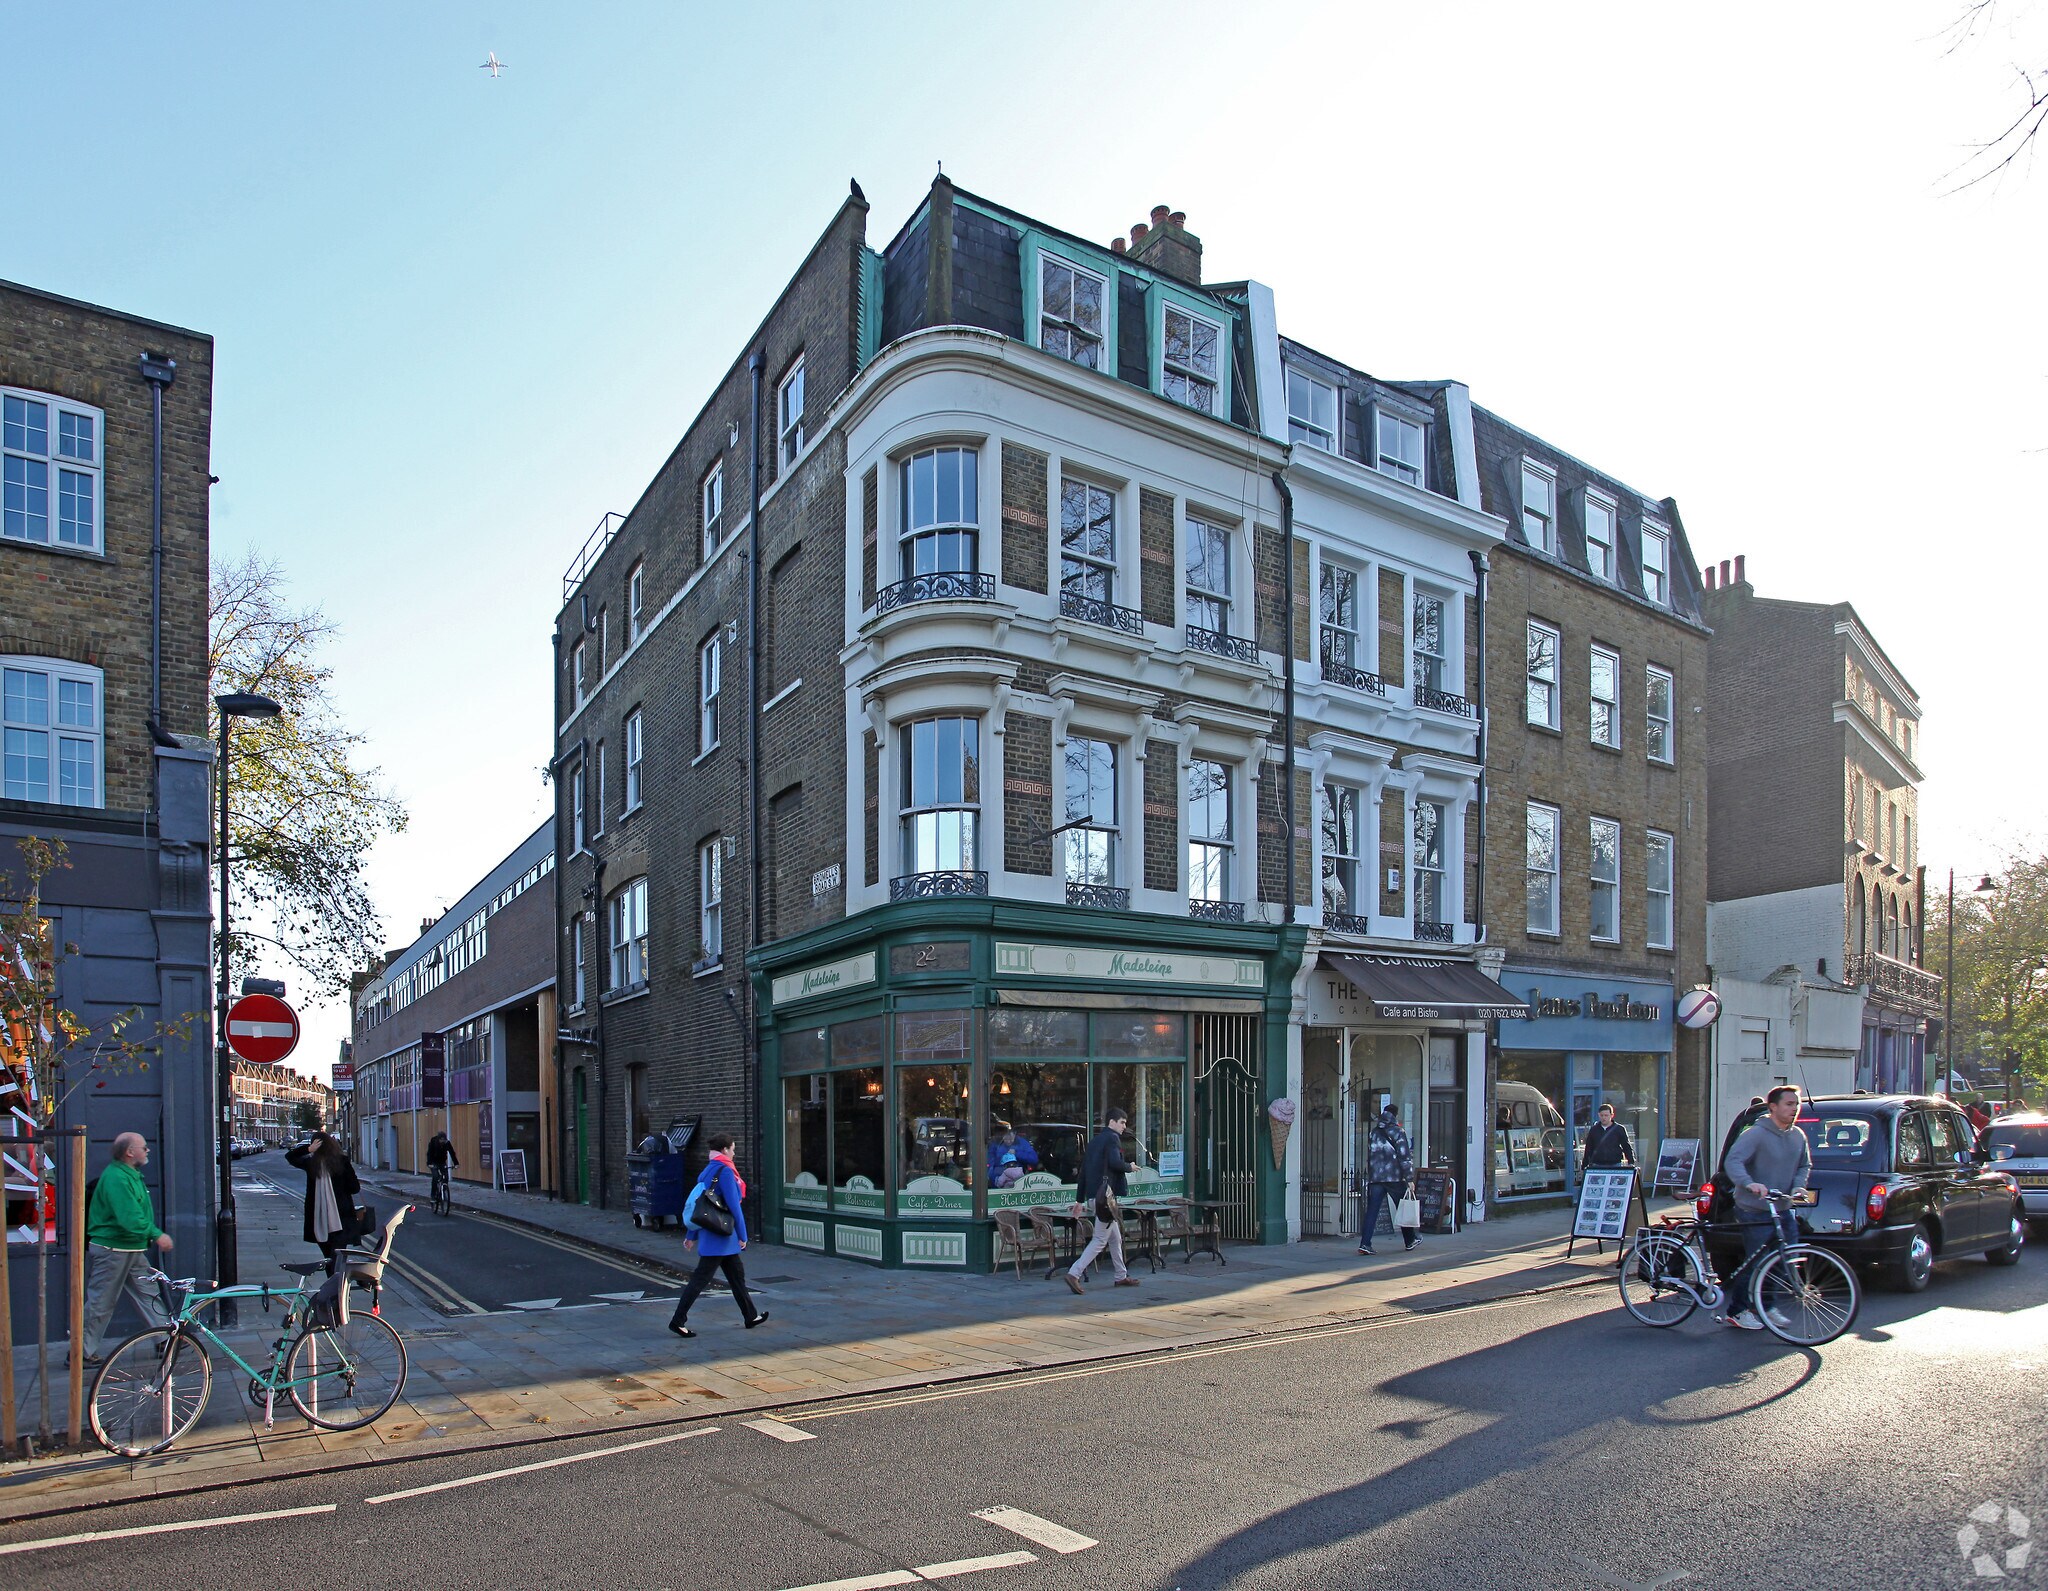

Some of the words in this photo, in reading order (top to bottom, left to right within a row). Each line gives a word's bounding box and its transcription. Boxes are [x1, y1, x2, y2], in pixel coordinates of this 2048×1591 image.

[916, 944, 937, 967] 22
[1107, 953, 1172, 978] Madeleine
[800, 970, 840, 995] Madeleine
[1327, 981, 1357, 1000] THE
[1382, 1006, 1401, 1018] Cafe
[1402, 1007, 1416, 1018] and
[1418, 1007, 1439, 1019] Bistro
[1478, 1008, 1492, 1019] 020
[1492, 1008, 1510, 1019] 7622
[1000, 1193, 1018, 1206] Hot
[1020, 1194, 1028, 1205] &
